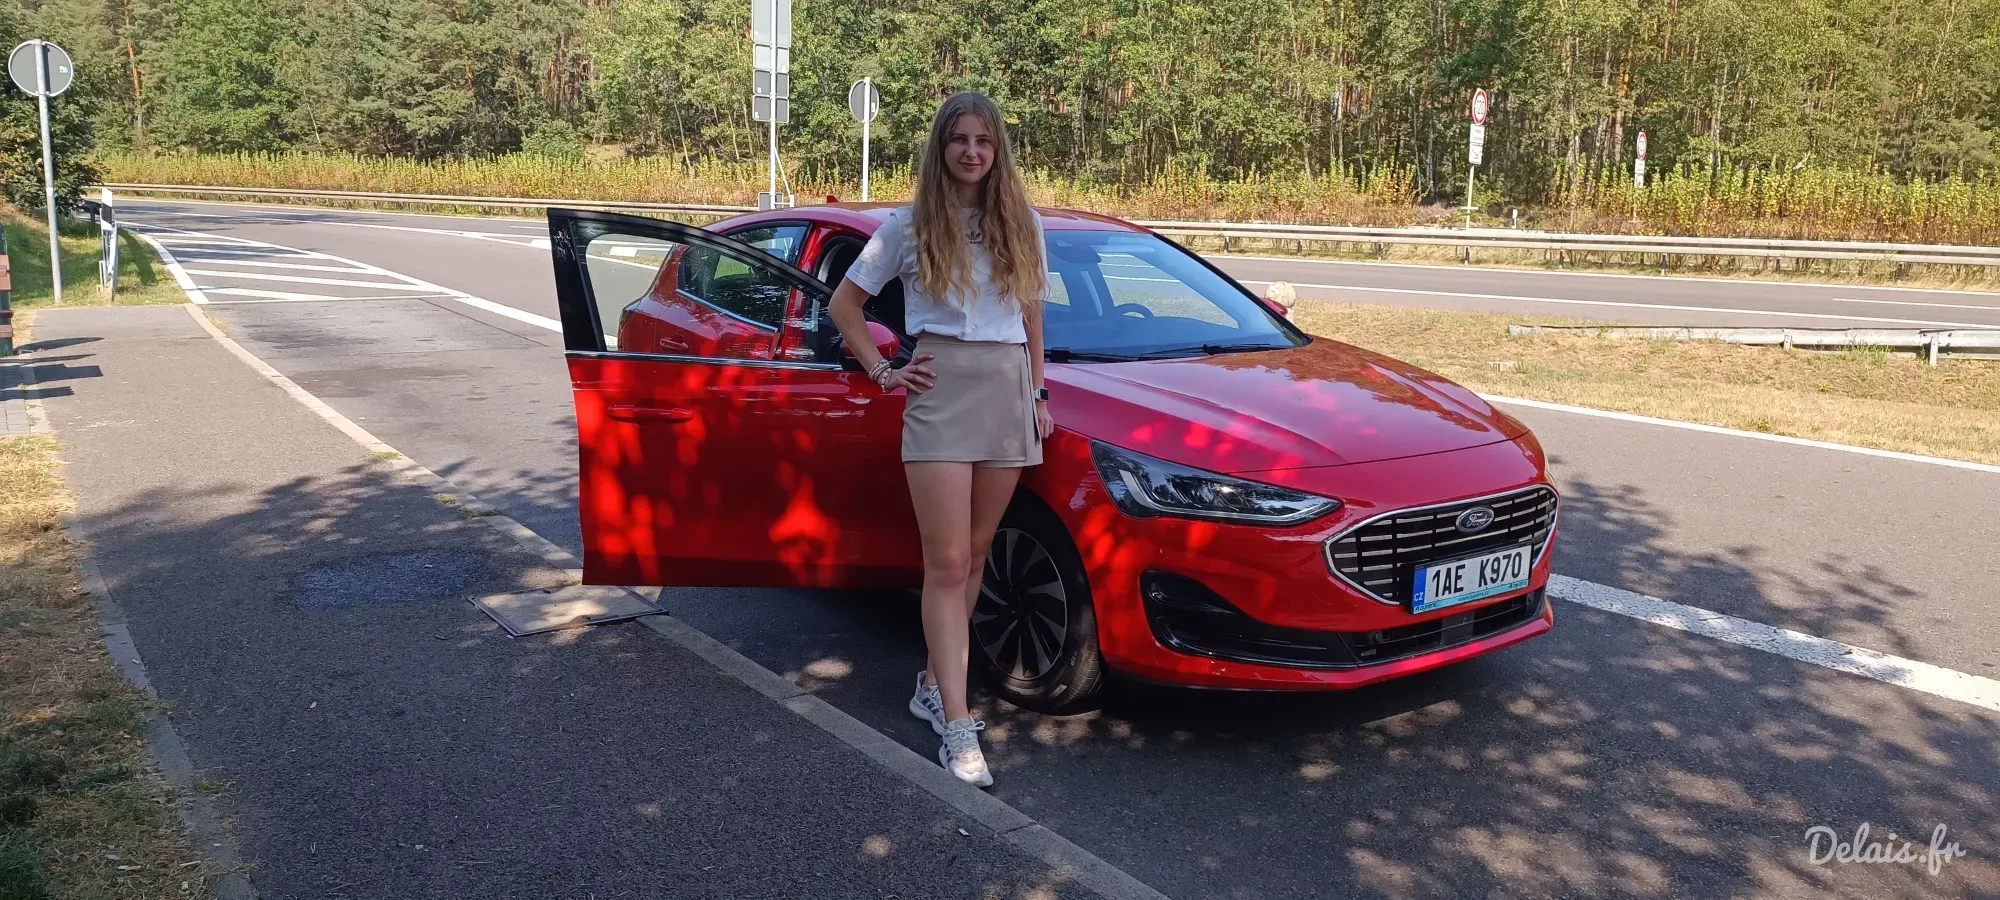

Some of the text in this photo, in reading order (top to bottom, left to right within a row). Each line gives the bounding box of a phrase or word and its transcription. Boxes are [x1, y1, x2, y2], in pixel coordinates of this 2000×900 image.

[1466, 512, 1489, 527] Ford
[1432, 552, 1522, 597] 1AE K970
[1414, 592, 1424, 602] CZ
